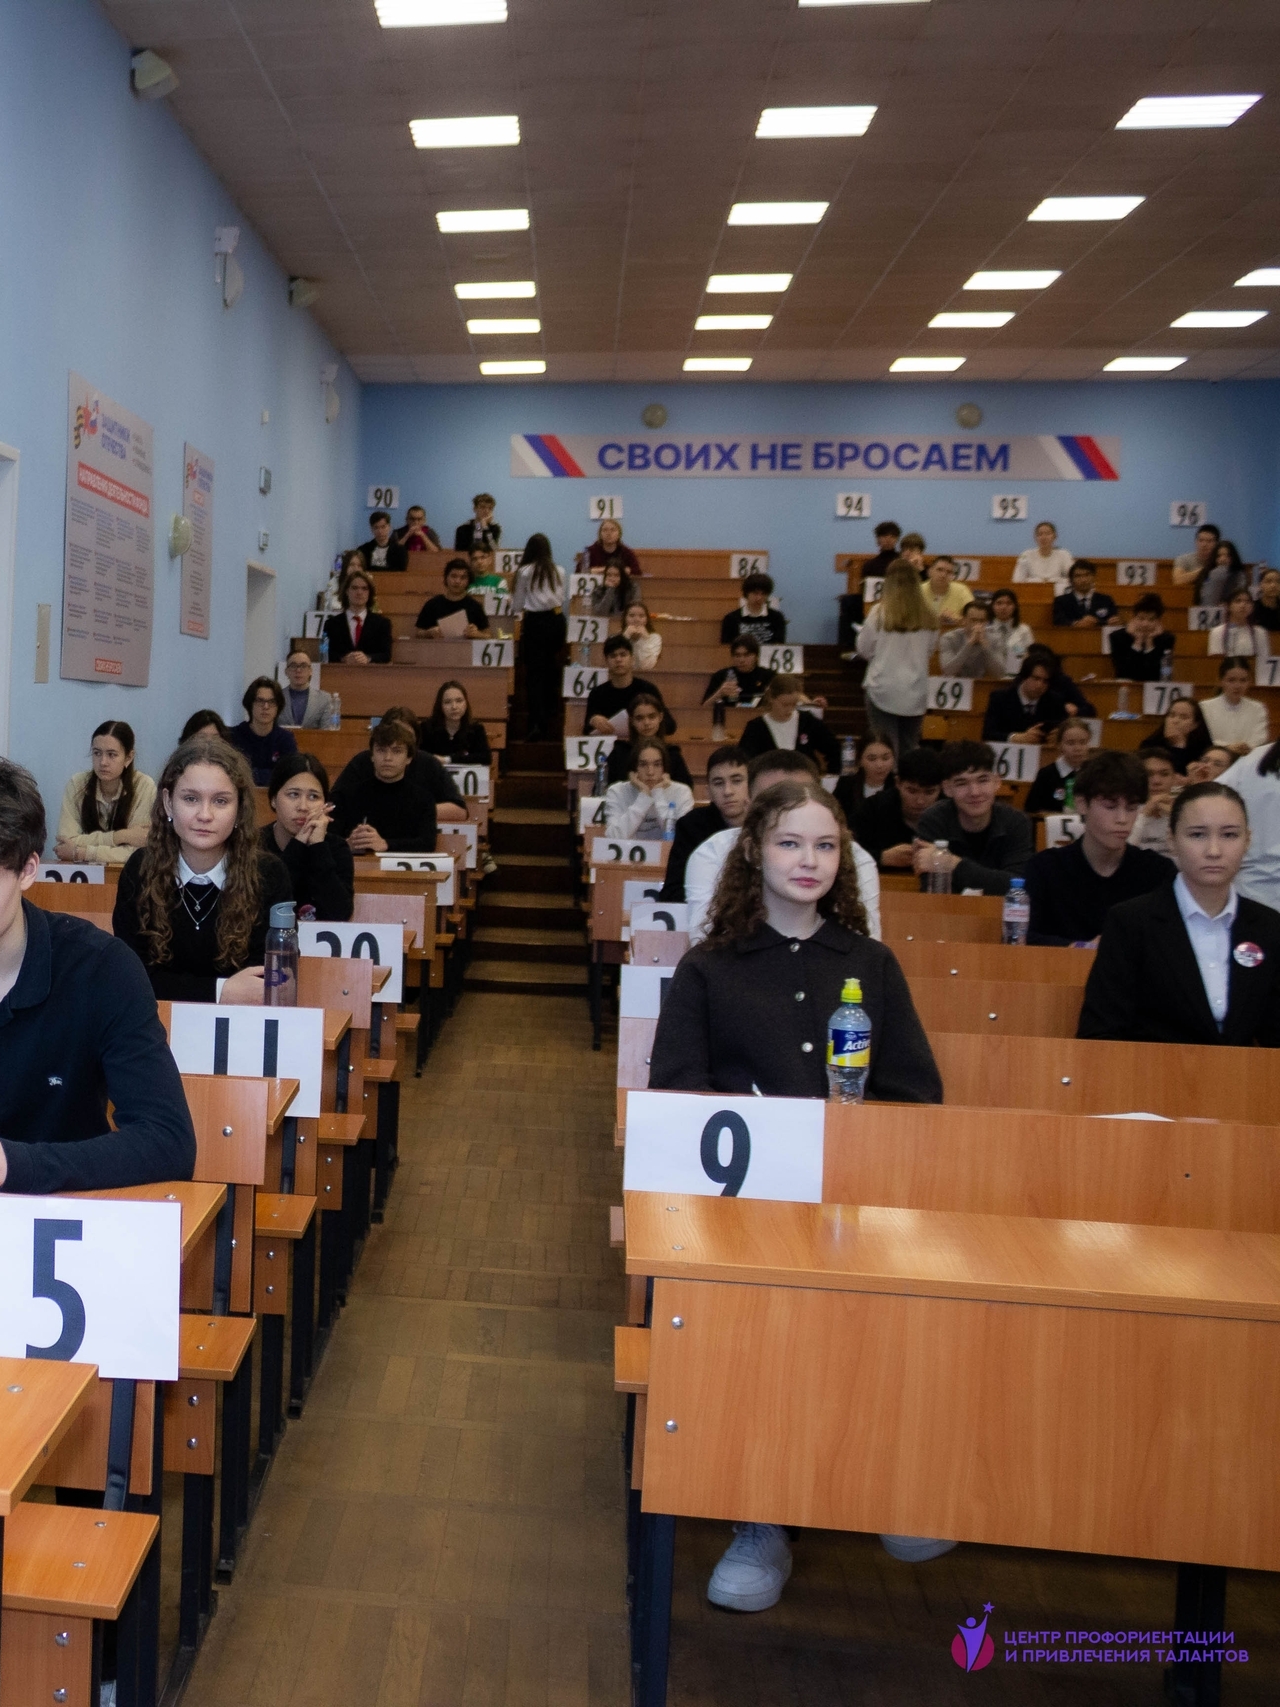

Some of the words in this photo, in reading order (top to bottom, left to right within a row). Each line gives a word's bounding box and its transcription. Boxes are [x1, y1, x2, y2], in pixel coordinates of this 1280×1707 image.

[598, 442, 740, 471] СВОИХ
[750, 442, 804, 471] НЕ
[812, 441, 1011, 472] БРОСАЕМ
[374, 488, 394, 508] 90
[597, 498, 614, 519] 91
[843, 496, 864, 515] 94
[999, 497, 1020, 518] 95
[1177, 504, 1200, 524] 96
[1125, 565, 1148, 584] 93
[578, 619, 600, 641] 73
[482, 643, 504, 666] 67
[770, 649, 794, 673] 68
[573, 671, 598, 697] 64
[1266, 660, 1278, 684] 7
[935, 681, 964, 709] 69
[577, 740, 605, 768] 56
[997, 748, 1025, 779] 61
[592, 801, 606, 825] 4
[213, 1017, 279, 1078] 11
[700, 1109, 751, 1197] 9
[25, 1218, 86, 1362] 5
